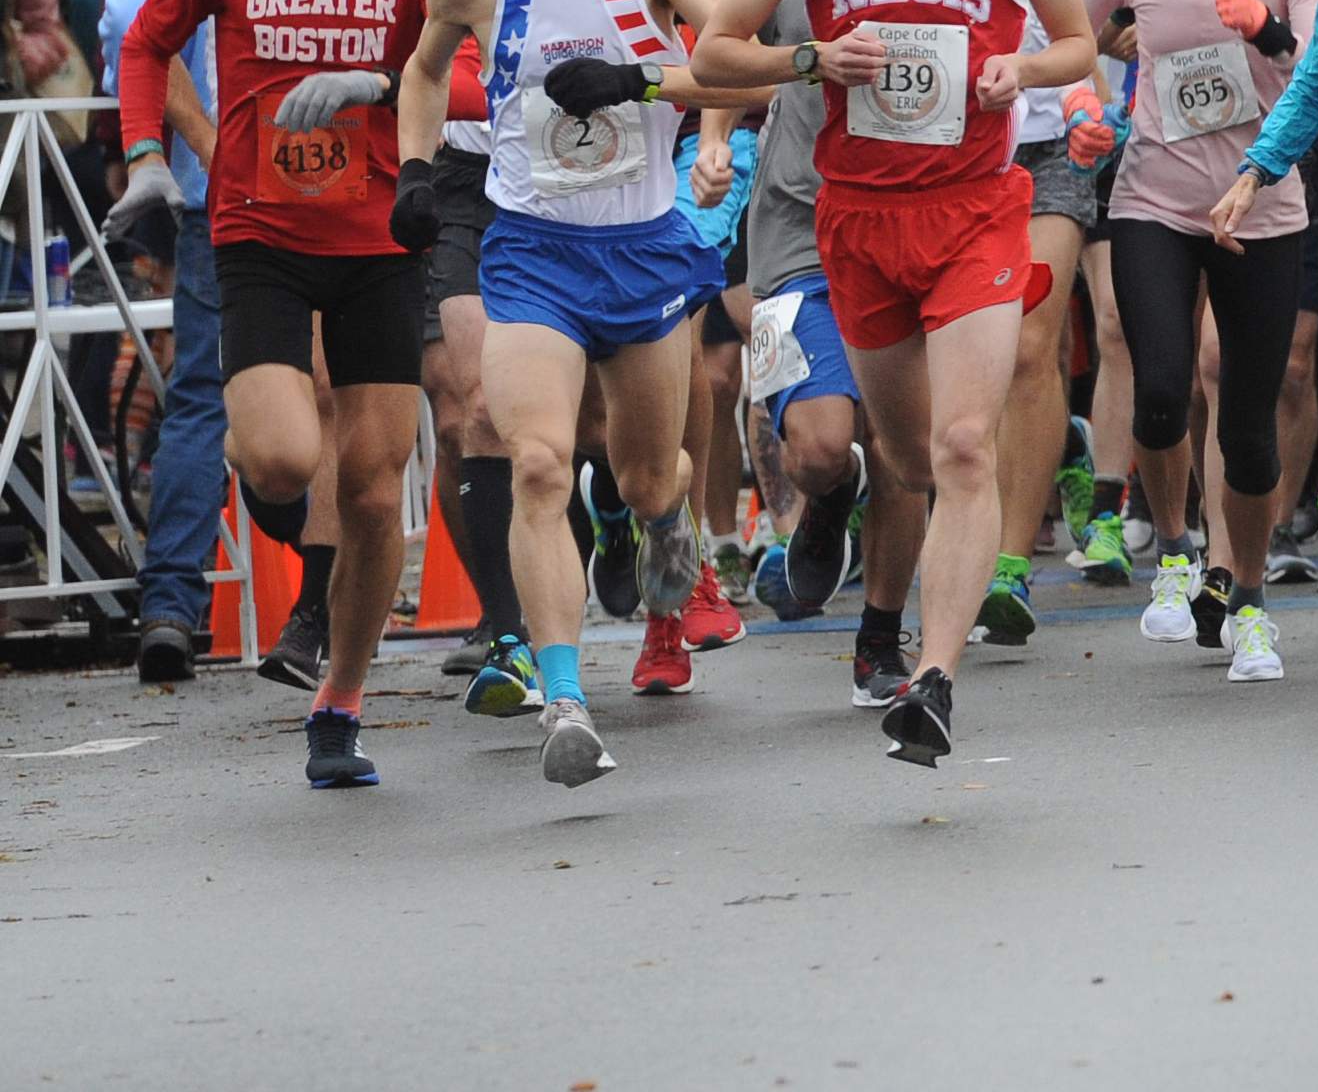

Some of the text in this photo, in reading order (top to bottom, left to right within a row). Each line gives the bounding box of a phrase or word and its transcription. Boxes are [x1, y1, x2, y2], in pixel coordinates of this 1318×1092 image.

[253, 23, 387, 62] BOSTON
[540, 37, 604, 54] MARATHON
[878, 27, 937, 41] Cape Cod
[885, 47, 937, 60] arathon
[1170, 47, 1219, 67] Cape Cod
[880, 63, 934, 93] 139
[896, 96, 922, 109] ERIC
[1179, 77, 1228, 110] 655
[574, 120, 594, 148] 2
[274, 140, 347, 173] 4138
